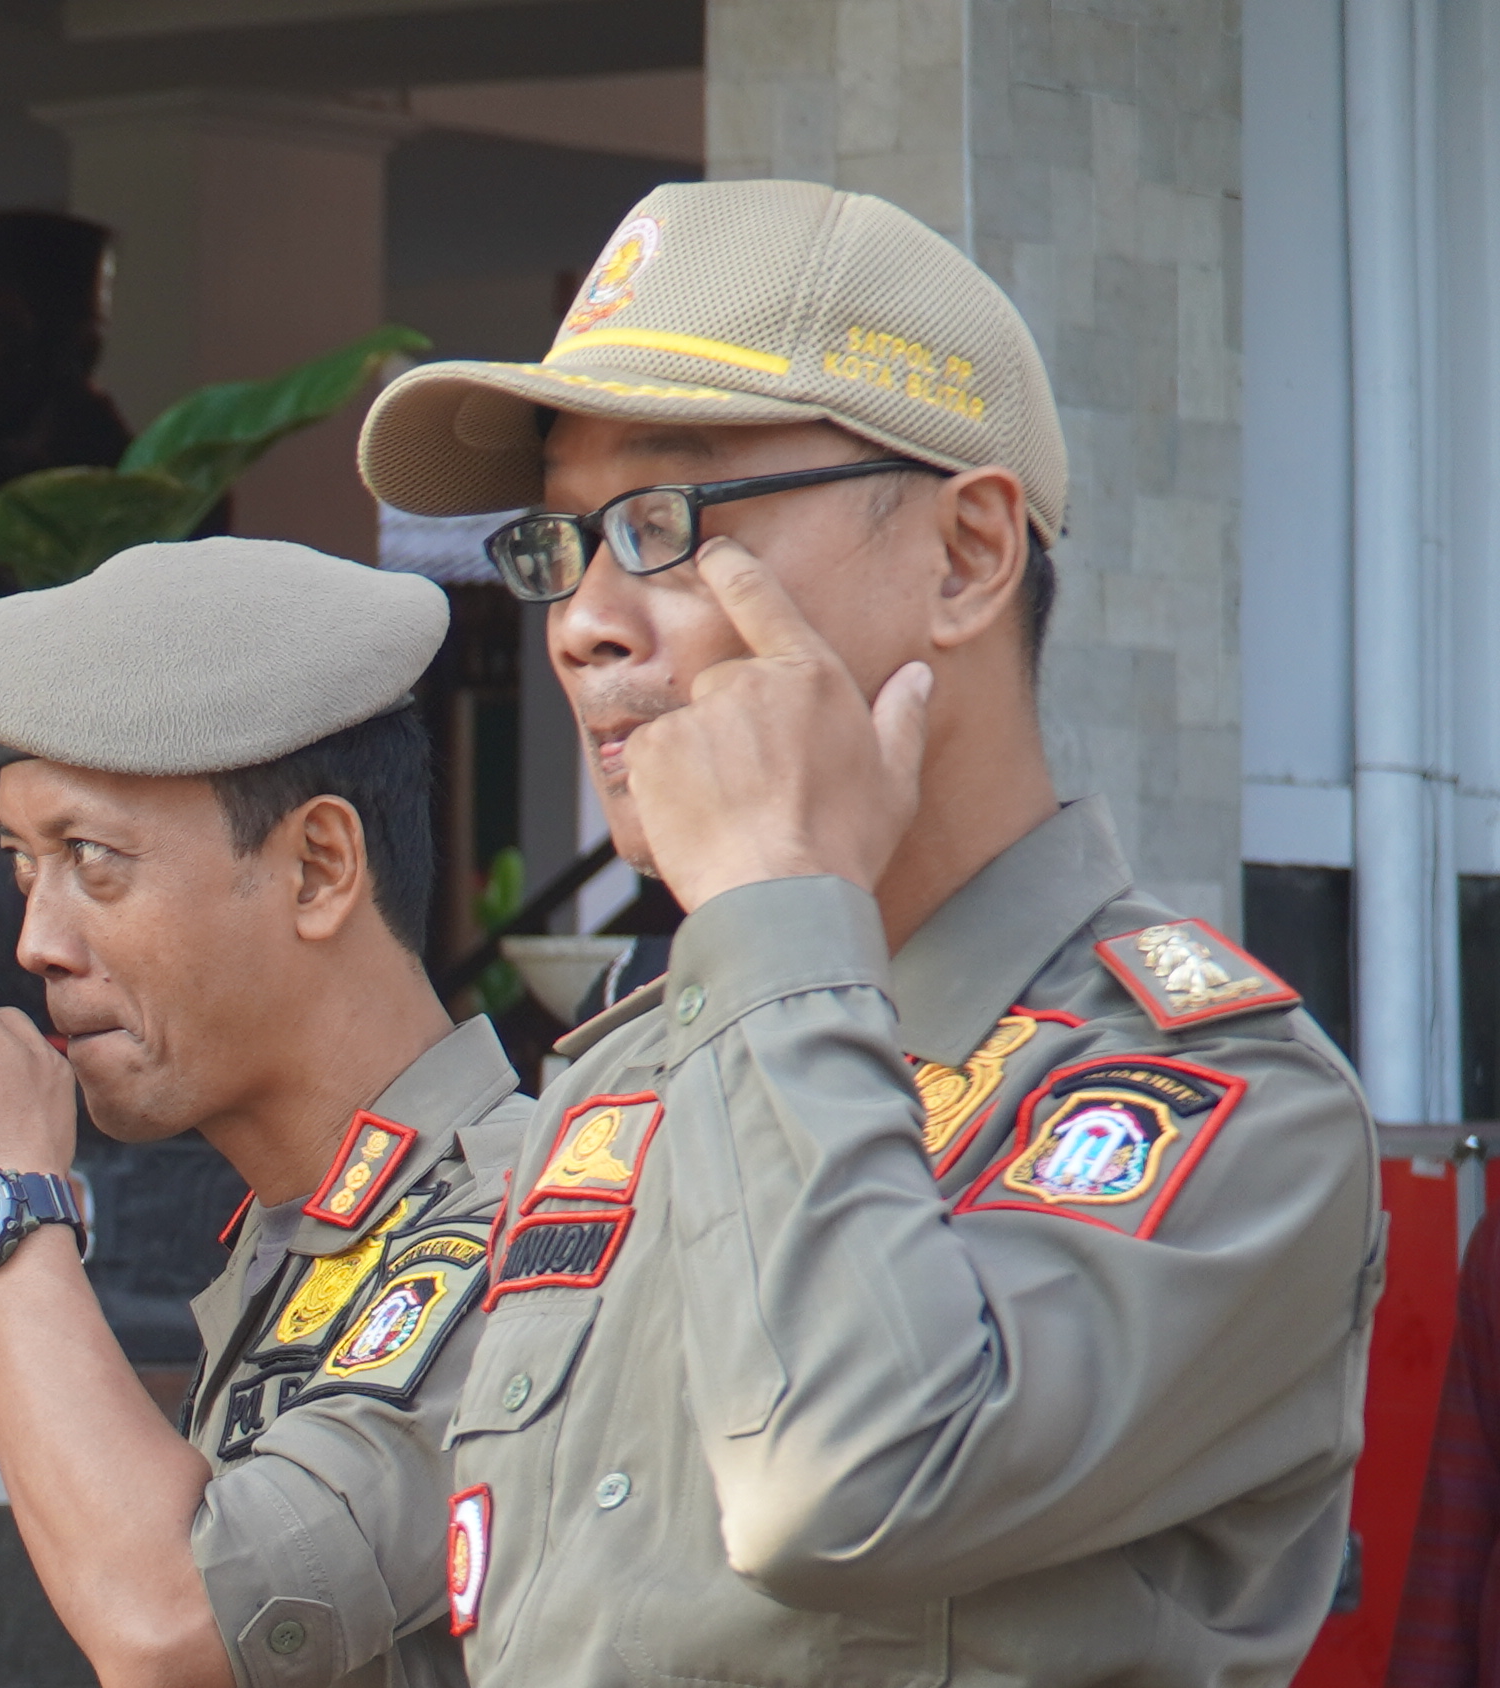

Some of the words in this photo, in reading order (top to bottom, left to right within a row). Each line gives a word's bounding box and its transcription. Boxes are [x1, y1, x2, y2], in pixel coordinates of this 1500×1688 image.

[823, 351, 893, 390] KOTA
[906, 373, 985, 422] BLITAR
[847, 325, 936, 374] SATPOL
[943, 355, 973, 384] PP
